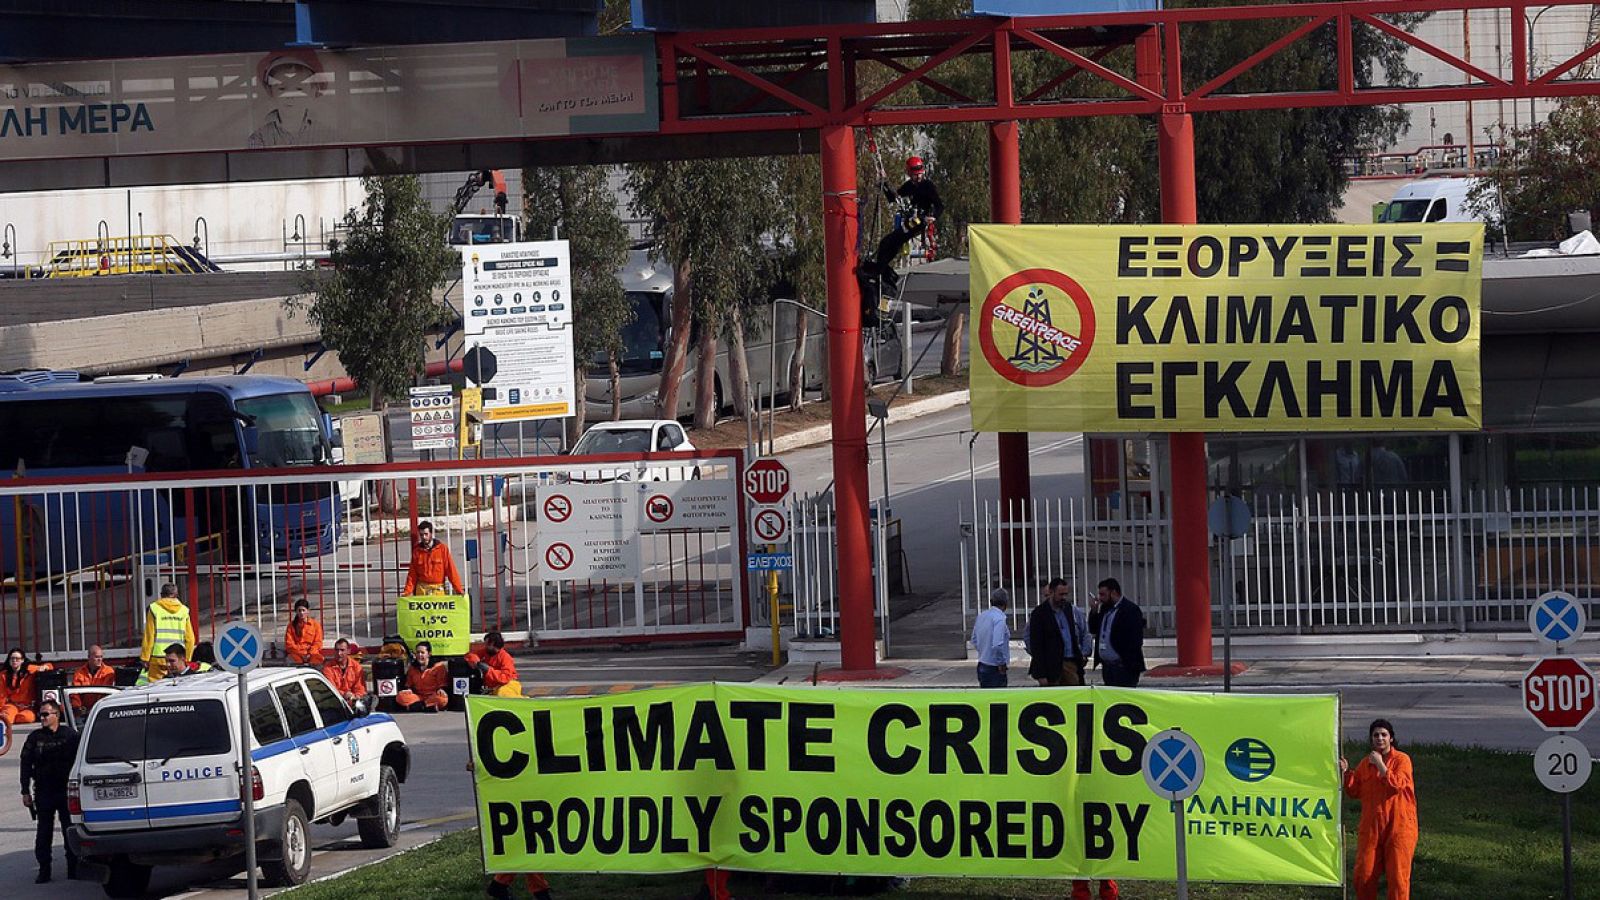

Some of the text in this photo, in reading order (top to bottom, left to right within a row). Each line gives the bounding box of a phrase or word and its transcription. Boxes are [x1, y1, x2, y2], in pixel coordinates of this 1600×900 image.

[59, 103, 154, 135] ΜΕΡΑ
[1118, 235, 1471, 278] ΕΞΟΡΥΞΕΙΣ =
[992, 304, 1082, 352] GREENPEACE
[1115, 294, 1471, 345] ΚΛΙΜΑΤΙΚΟ
[1115, 360, 1468, 419] ΕΓΚΛΗΜΑ
[747, 469, 788, 494] STOP
[748, 556, 793, 568] ΕΛΕΓΧΟΣ
[408, 601, 455, 610] ΕΧΟΥΜΕ
[415, 629, 453, 638] ΔΙΟΡΙΑ
[1528, 674, 1590, 712] STOP
[109, 705, 195, 719] ΕΛΛΗΝΙΚΗ ΑΣΤΥΝΟΜΙΑ
[476, 700, 1149, 779] CLIMATE CRISIS
[162, 766, 223, 781] POLICE
[1548, 753, 1578, 776] 20
[488, 794, 1150, 862] PROUDLY SPONSORED BY
[1188, 819, 1313, 839] ΠΕΤΡΕΛΑΙΑ
